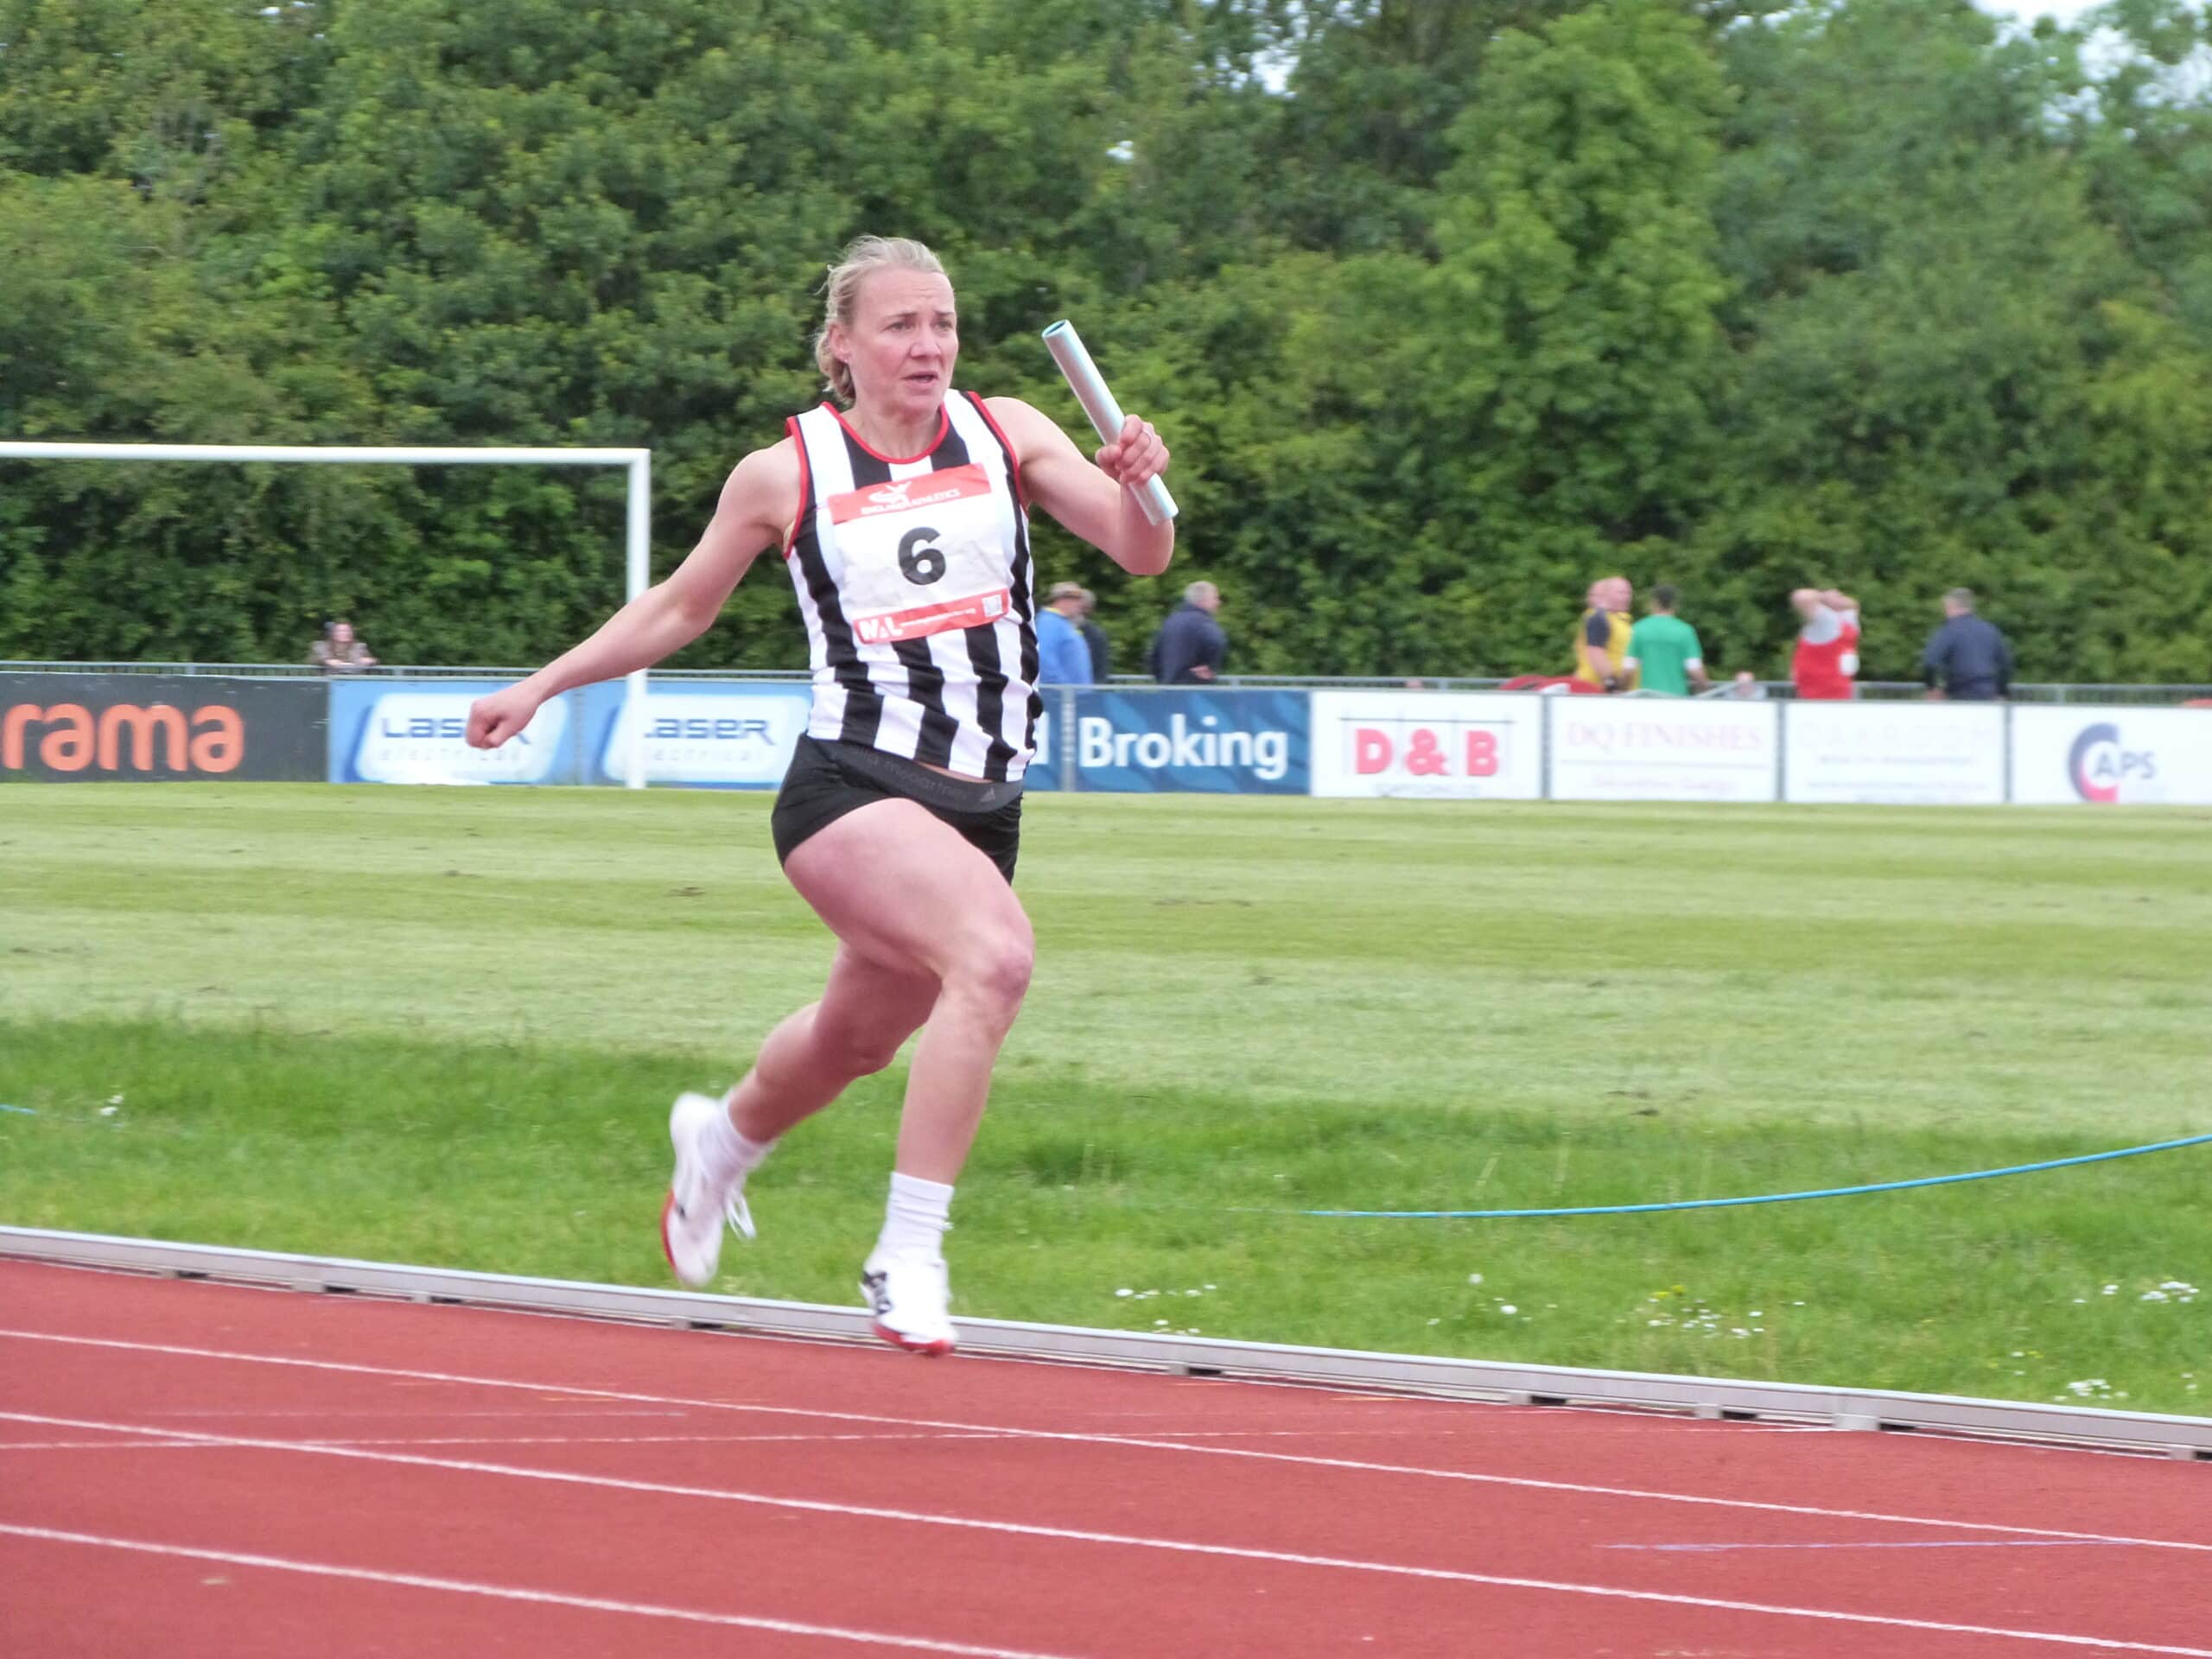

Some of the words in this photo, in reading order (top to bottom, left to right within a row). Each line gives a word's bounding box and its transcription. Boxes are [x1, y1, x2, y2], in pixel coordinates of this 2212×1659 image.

[899, 527, 946, 586] 6
[3, 703, 244, 772] rama
[1079, 713, 1288, 780] Broking
[1356, 728, 1394, 774] D
[1405, 728, 1452, 776] &
[1465, 730, 1498, 777] B
[1625, 721, 1763, 751] FINISHES
